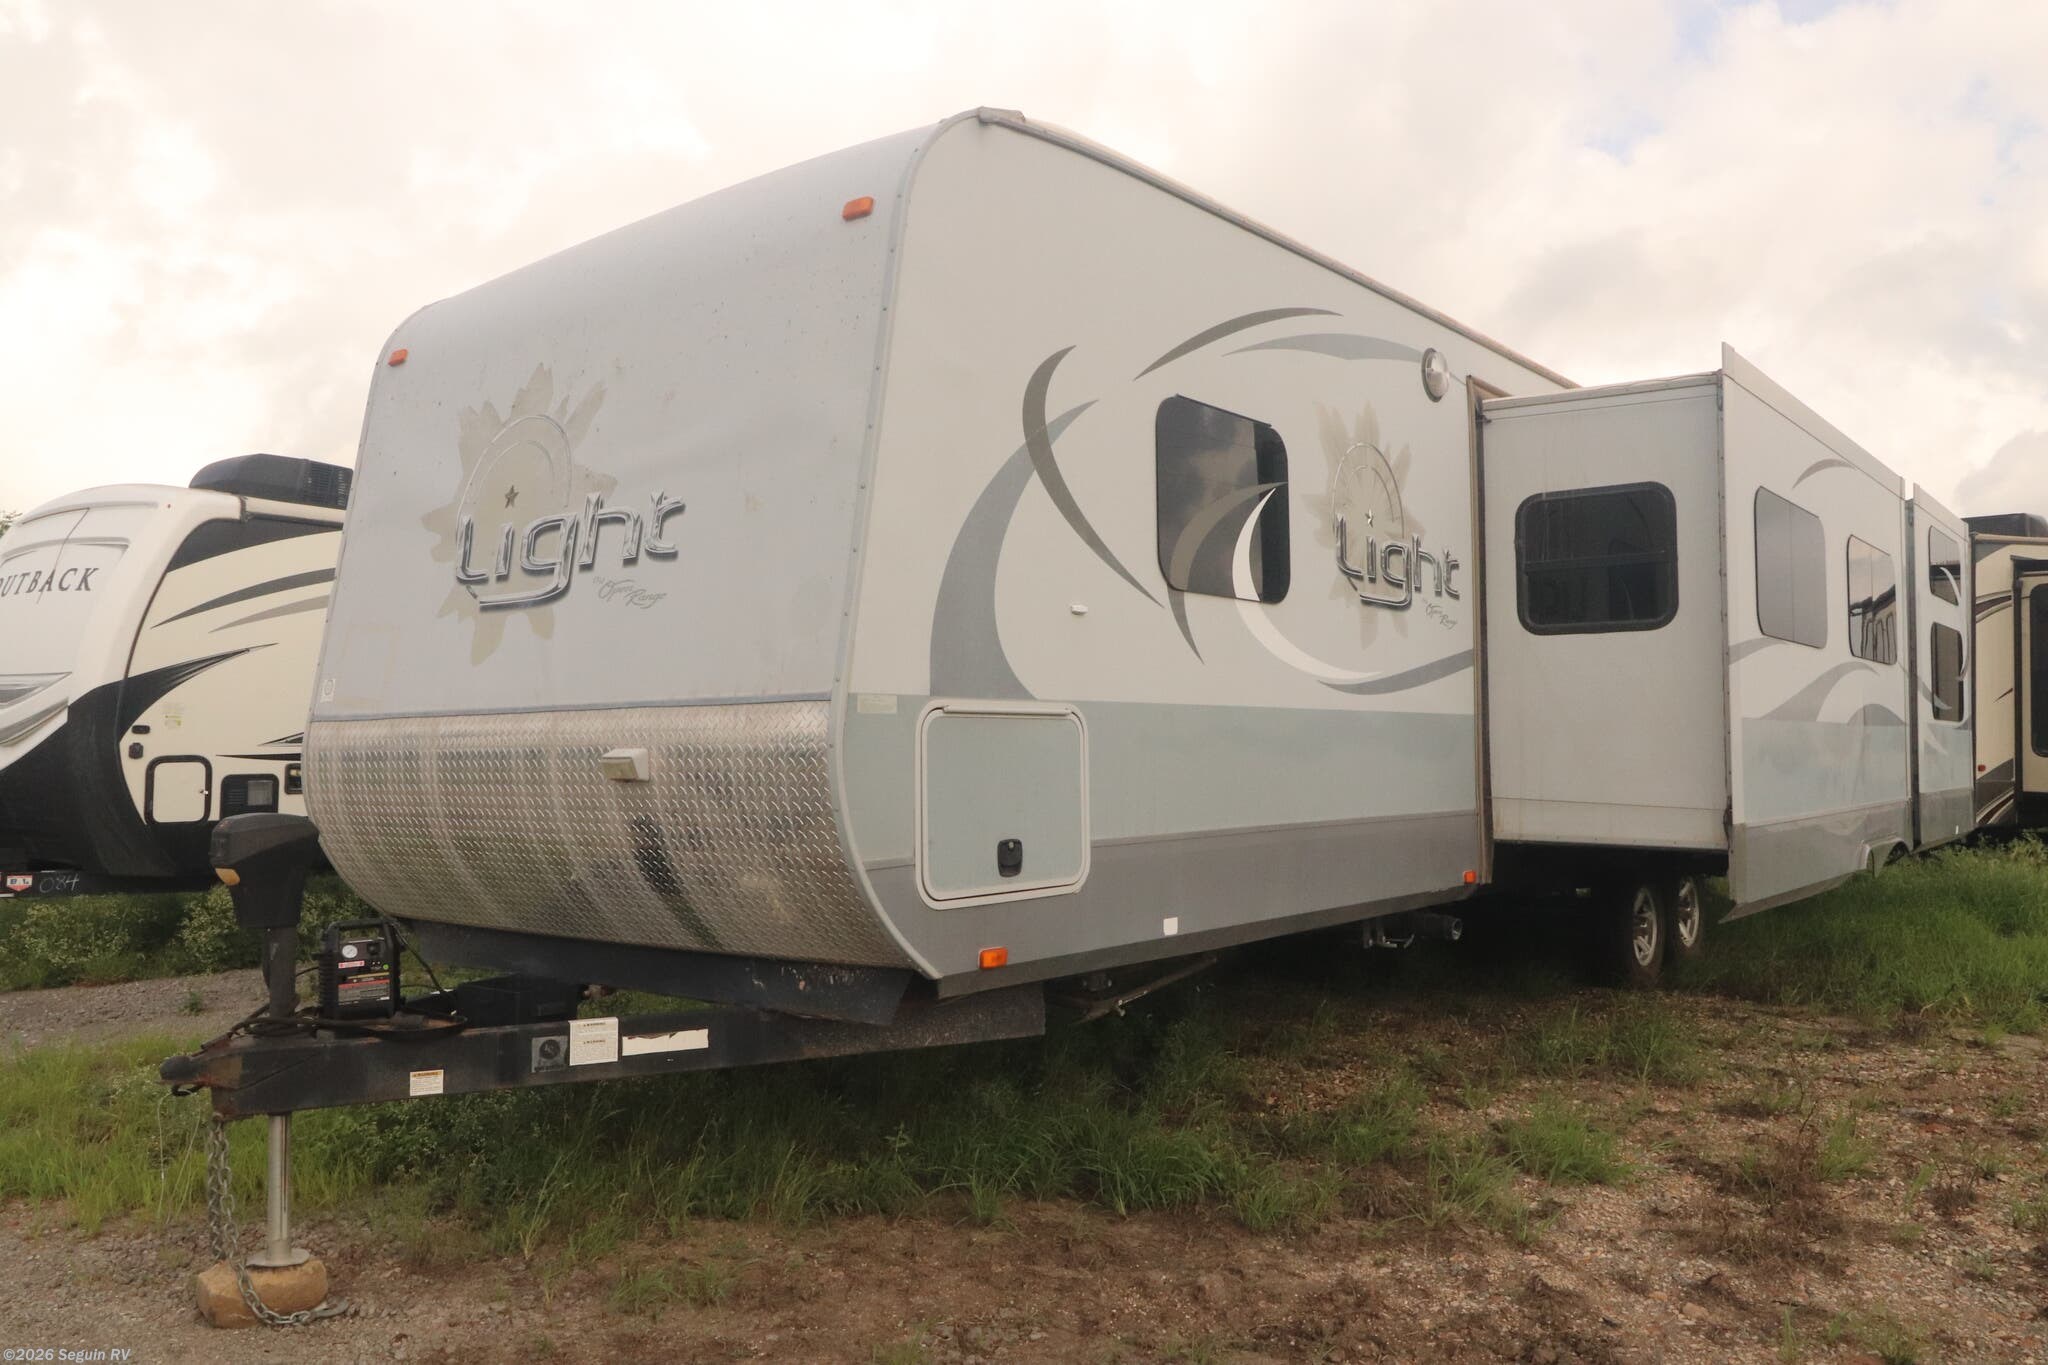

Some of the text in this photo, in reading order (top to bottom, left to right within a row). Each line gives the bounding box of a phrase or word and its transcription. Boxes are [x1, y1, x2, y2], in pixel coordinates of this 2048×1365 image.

[0, 567, 99, 597] UTBACK
[456, 486, 685, 612] Light
[1335, 511, 1460, 611] Light
